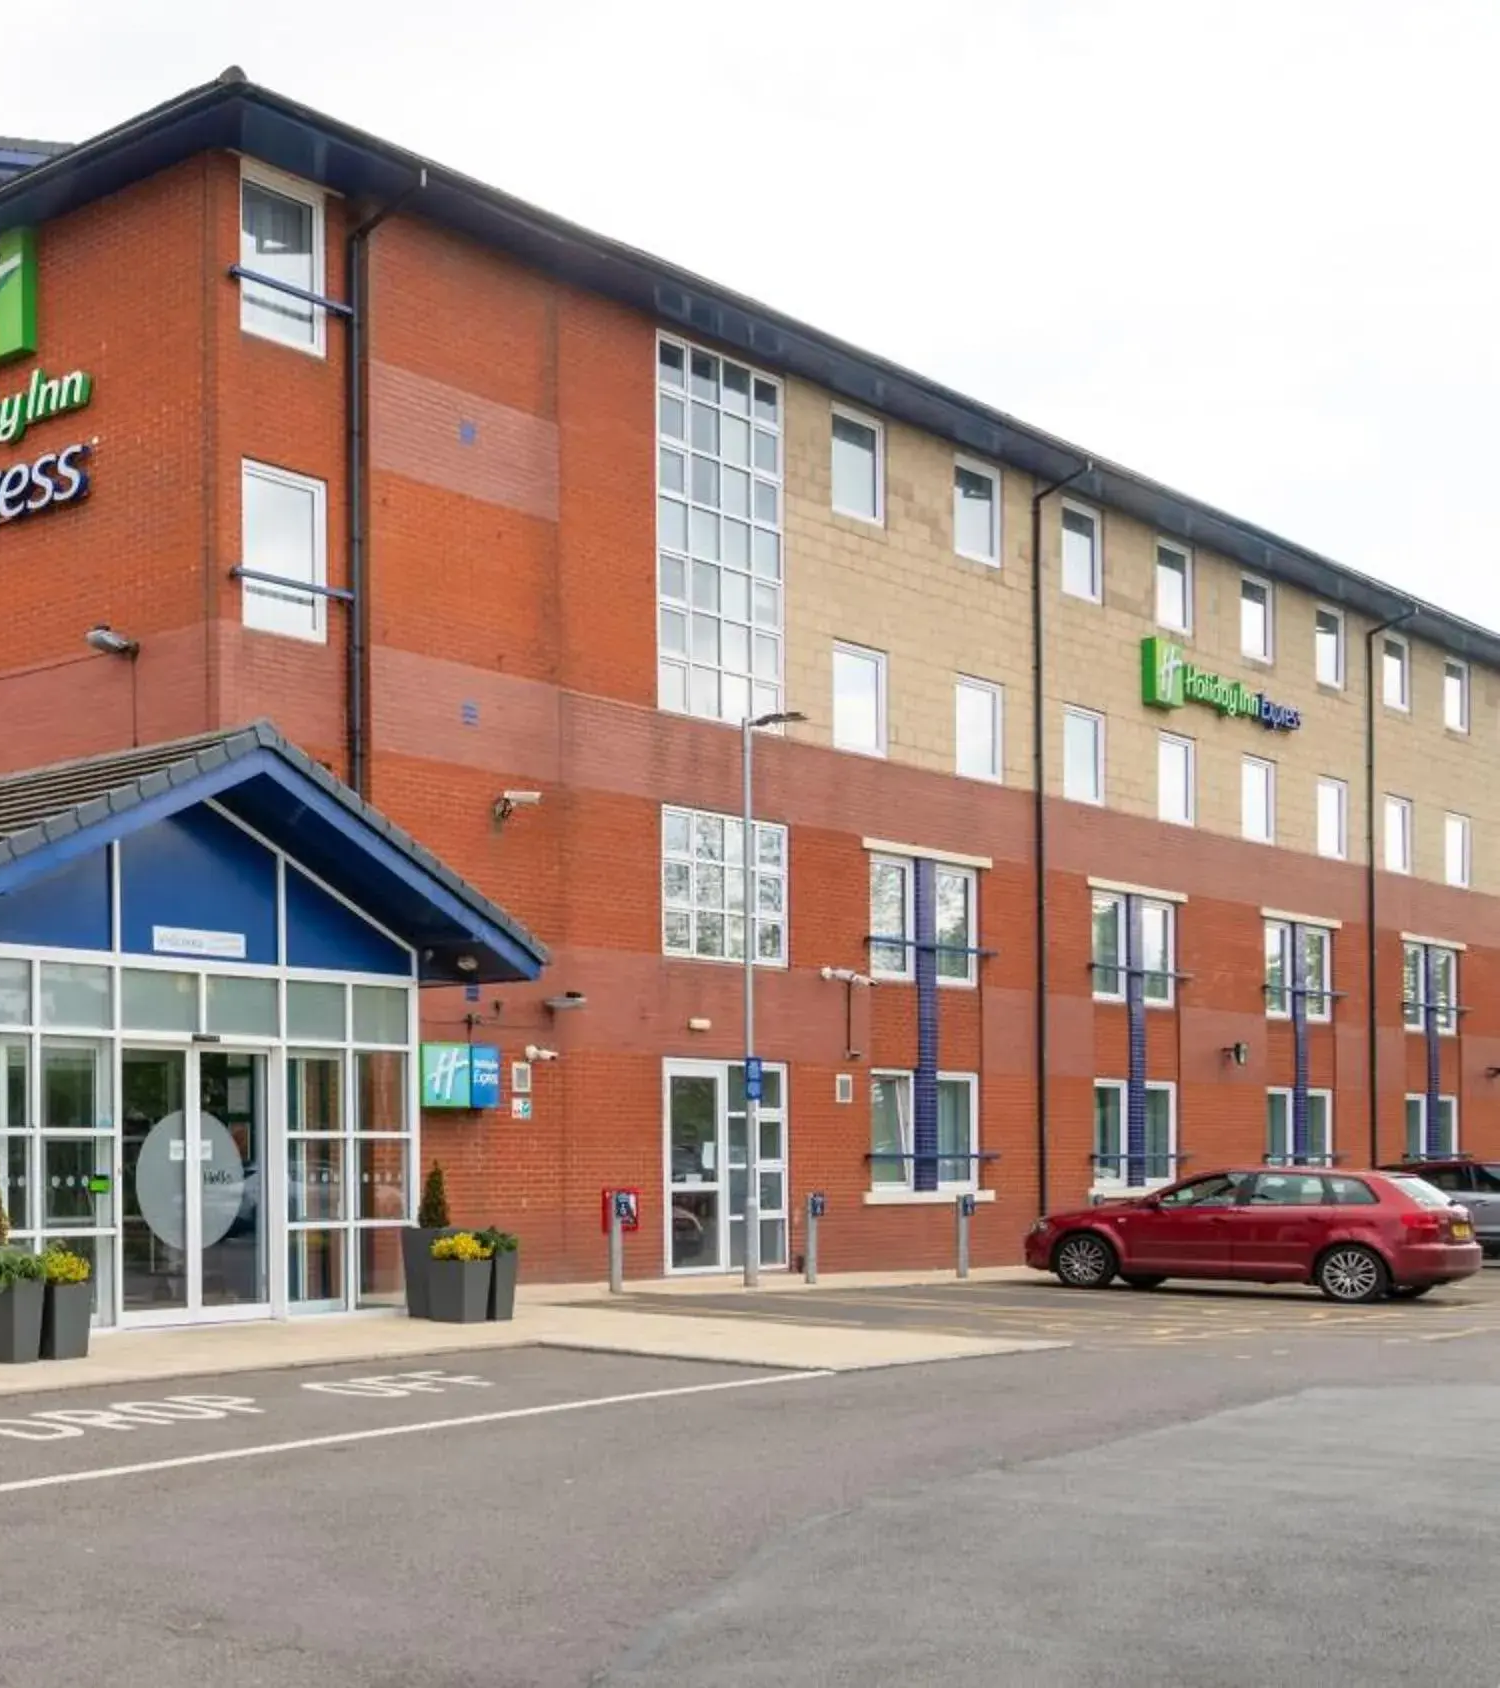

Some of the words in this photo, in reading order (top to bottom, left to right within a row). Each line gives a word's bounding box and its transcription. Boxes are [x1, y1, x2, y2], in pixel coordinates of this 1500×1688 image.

[27, 367, 88, 423] Inn
[1186, 664, 1238, 716] Holiday
[1239, 682, 1260, 717] Inn
[301, 1371, 495, 1398] OFF
